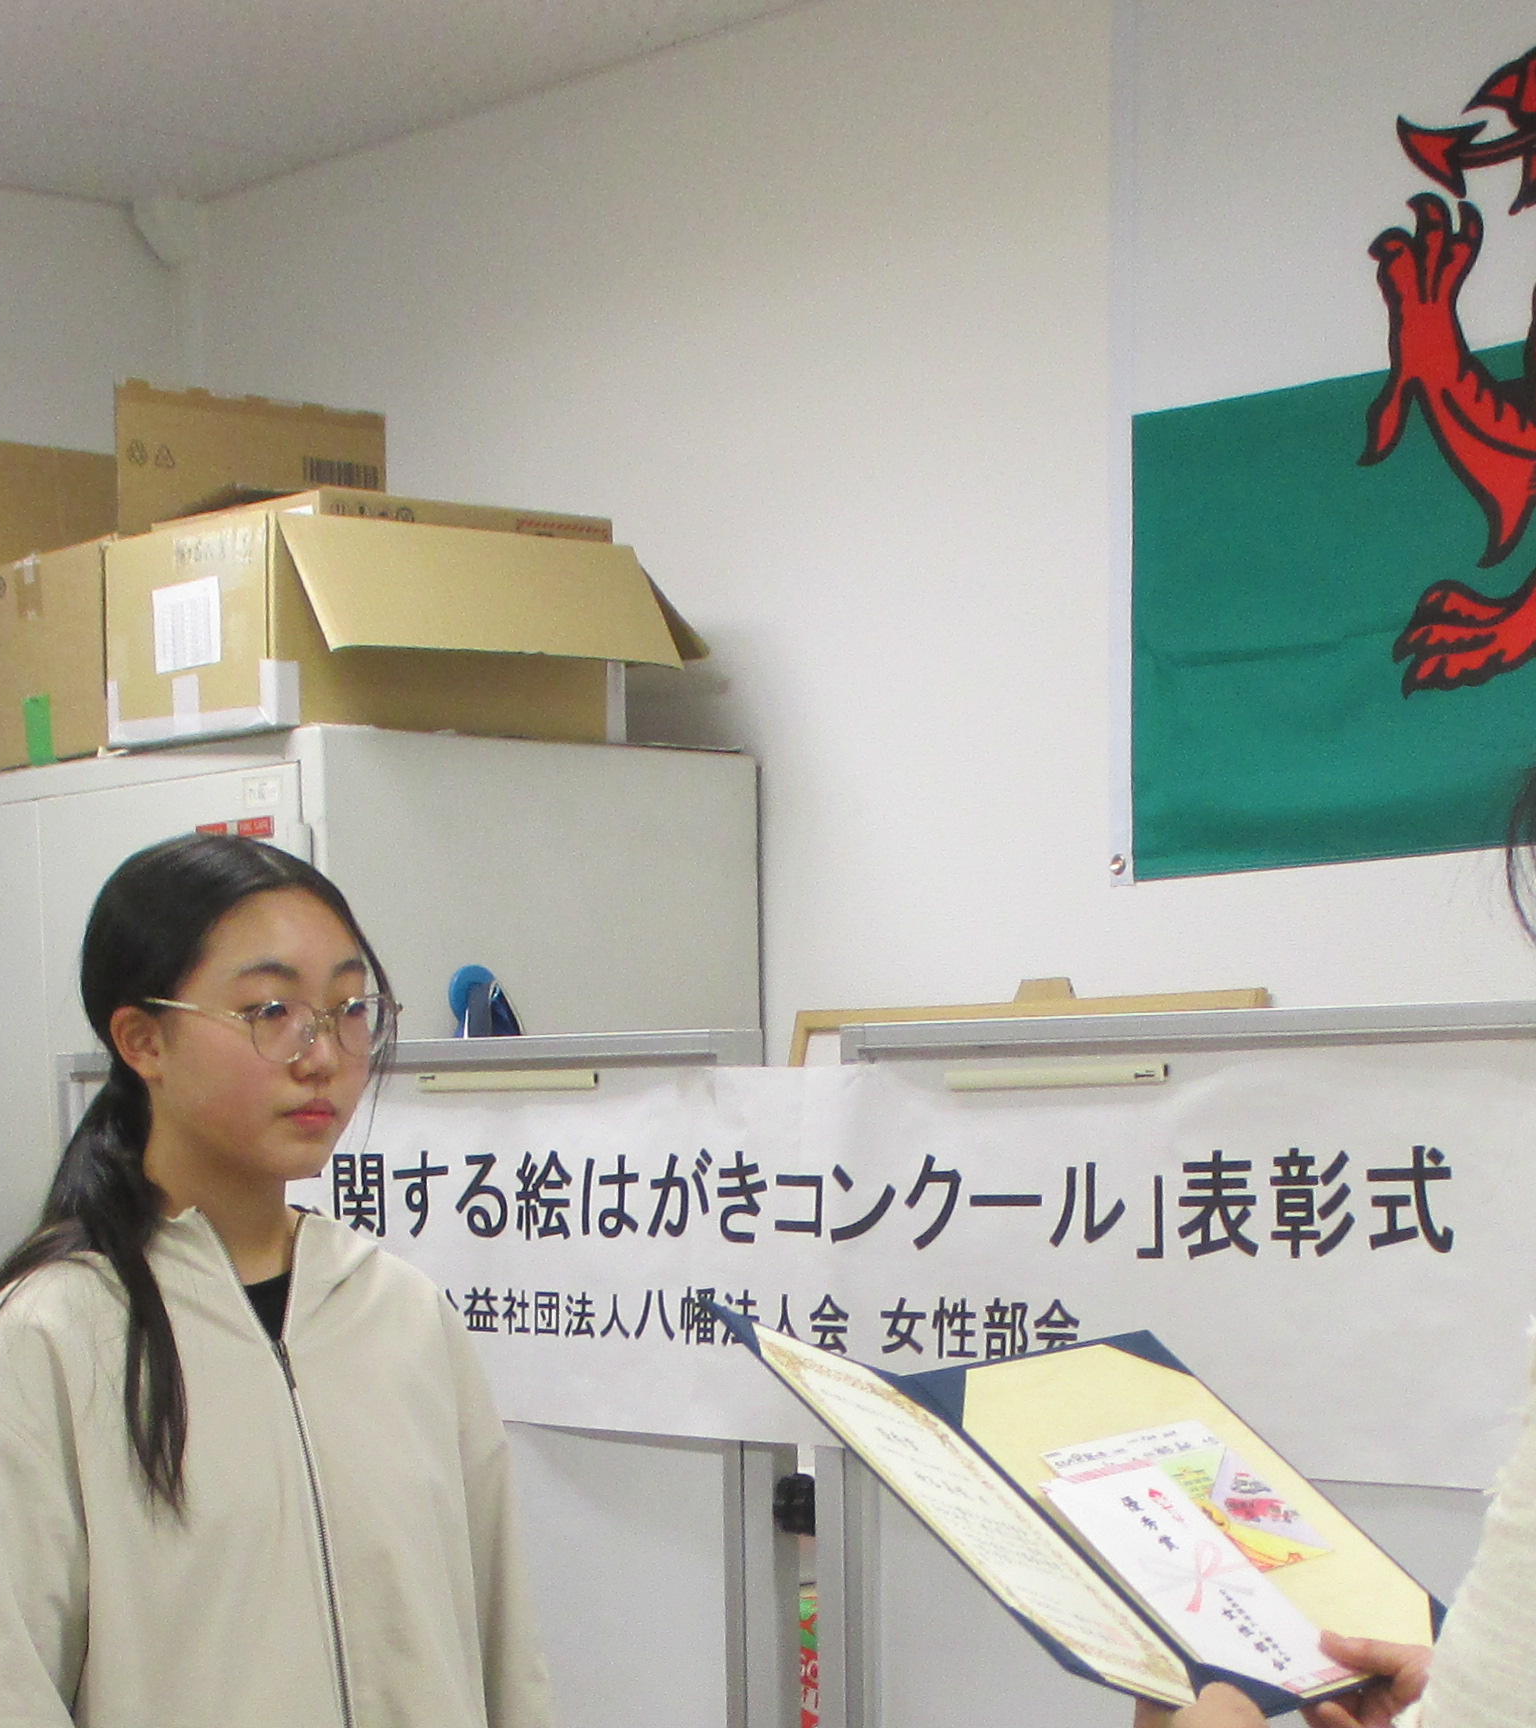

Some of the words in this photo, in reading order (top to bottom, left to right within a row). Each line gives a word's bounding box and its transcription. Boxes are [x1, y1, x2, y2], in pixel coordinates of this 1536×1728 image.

[288, 1144, 1456, 1261] 関する絵はがきコンクール」表彰式
[445, 1286, 850, 1354] 益社団法人八幡法人会
[880, 1297, 1080, 1359] 女性部会
